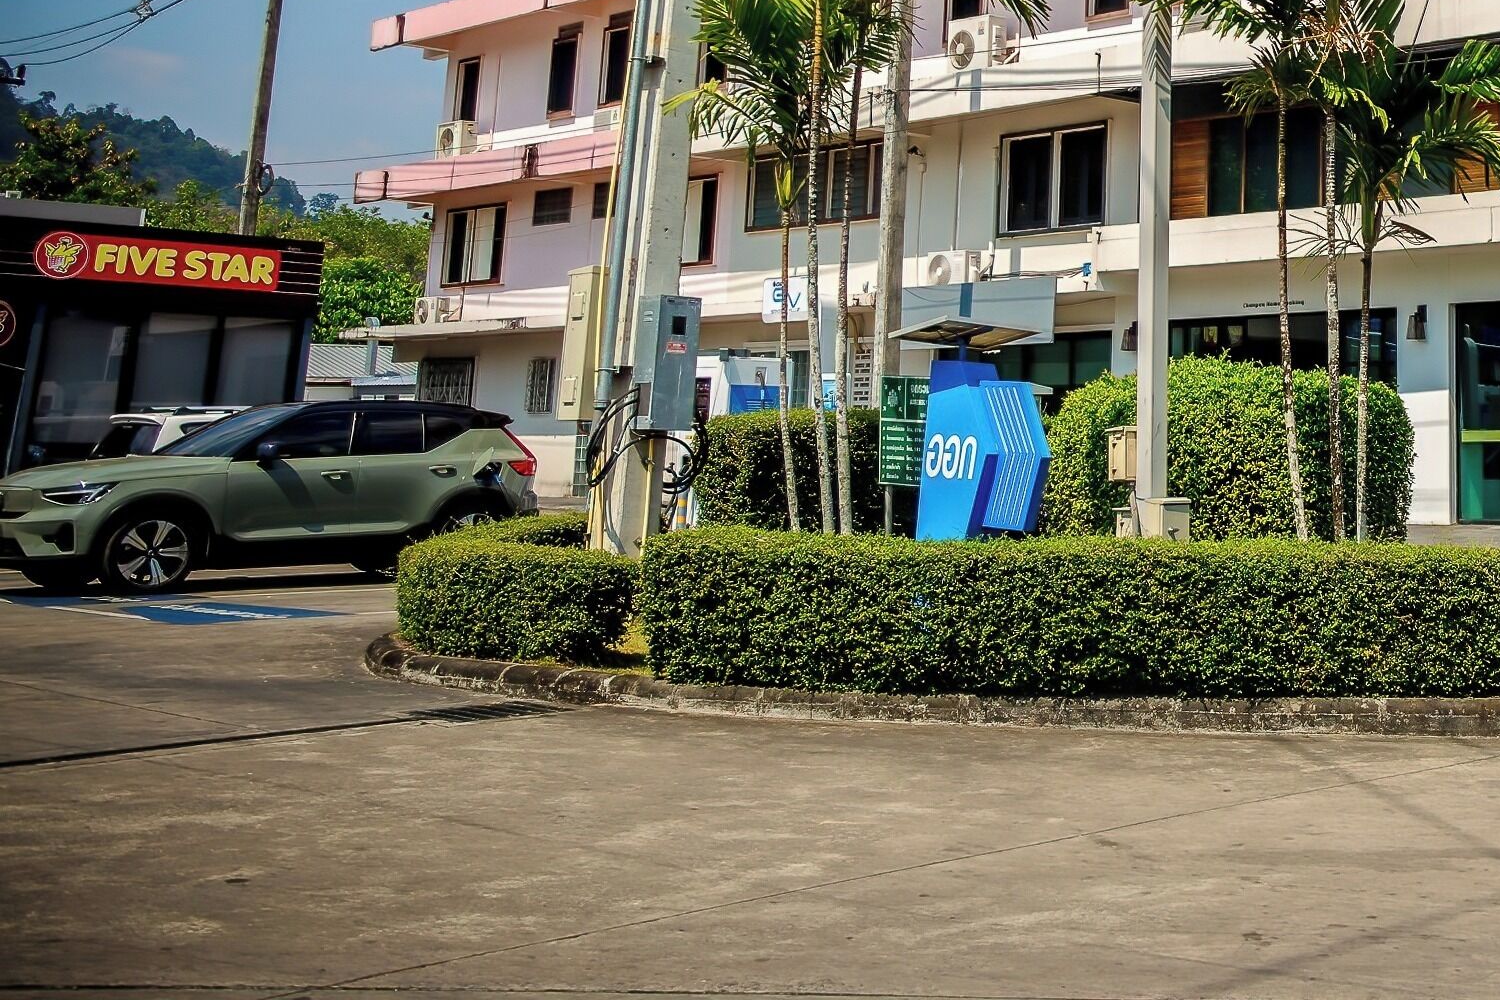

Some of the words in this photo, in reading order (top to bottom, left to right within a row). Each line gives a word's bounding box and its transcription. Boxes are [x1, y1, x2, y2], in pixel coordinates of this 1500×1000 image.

[94, 243, 178, 279] FIVE
[183, 249, 275, 286] STAR
[925, 433, 978, 480] ออก
